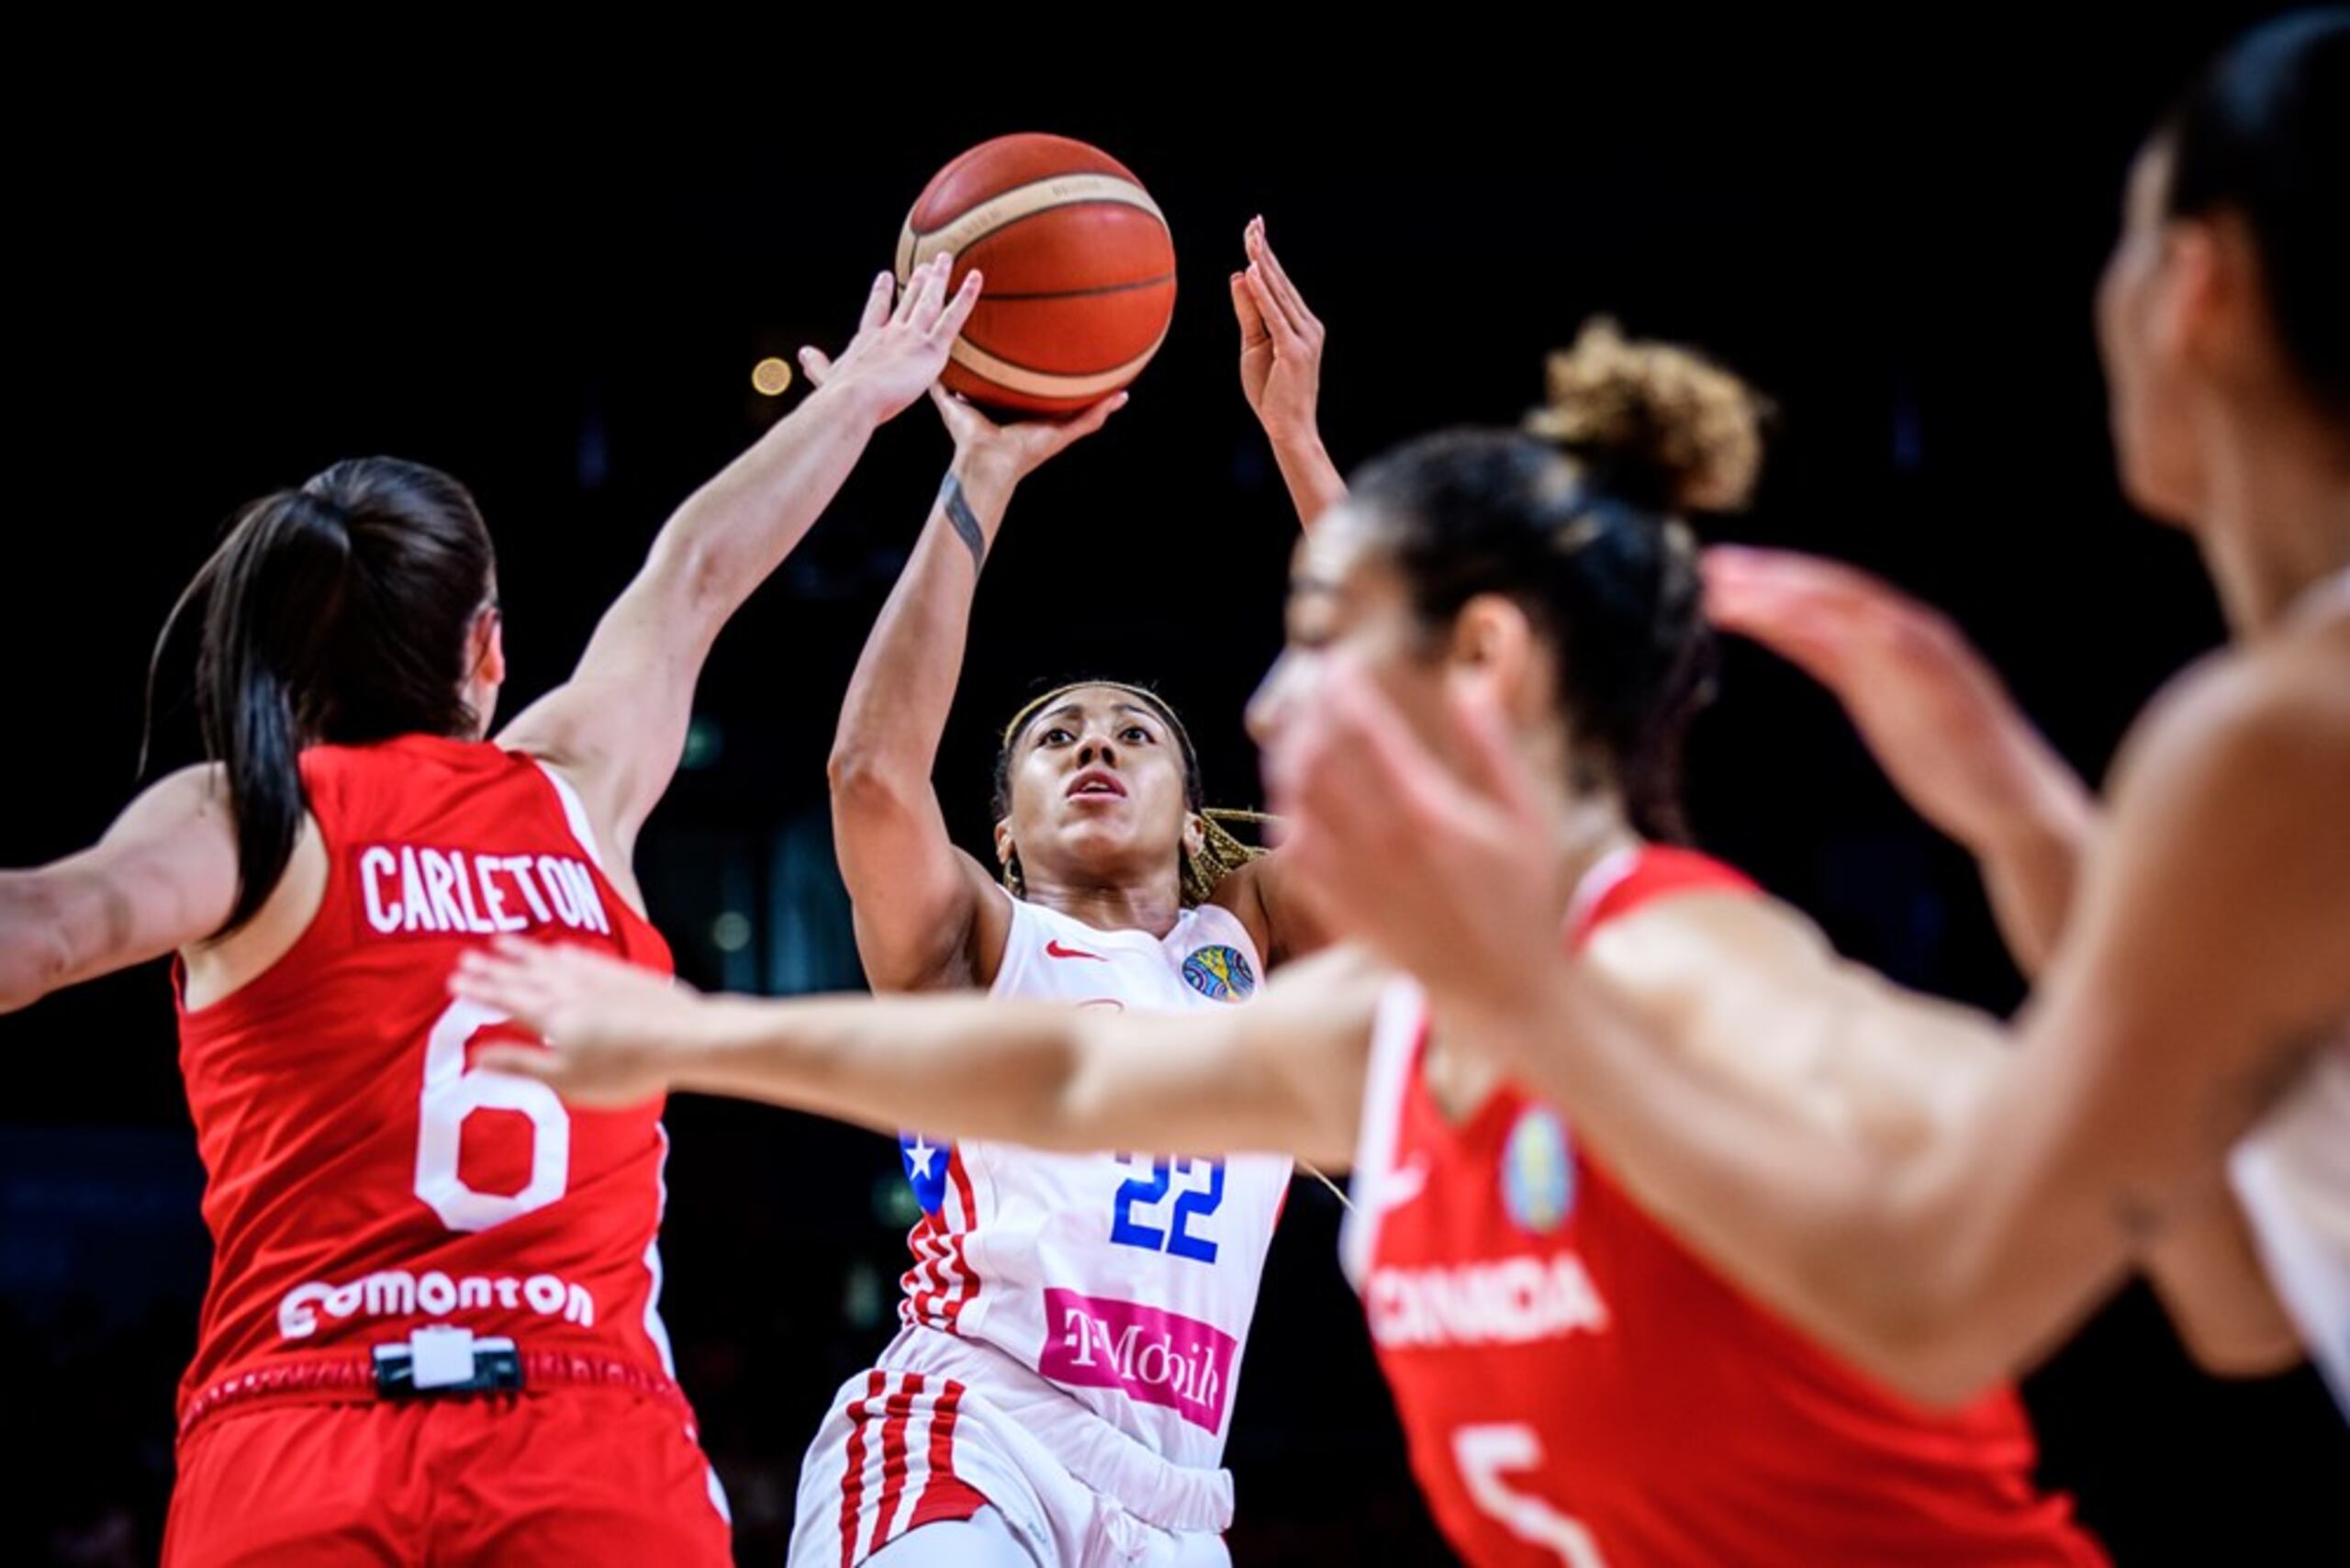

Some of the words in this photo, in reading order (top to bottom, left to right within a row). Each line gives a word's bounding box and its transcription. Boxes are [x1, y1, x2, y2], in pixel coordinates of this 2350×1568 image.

[360, 845, 610, 935] CARLETON
[414, 995, 570, 1232] 6
[1110, 1151, 1225, 1264] 22
